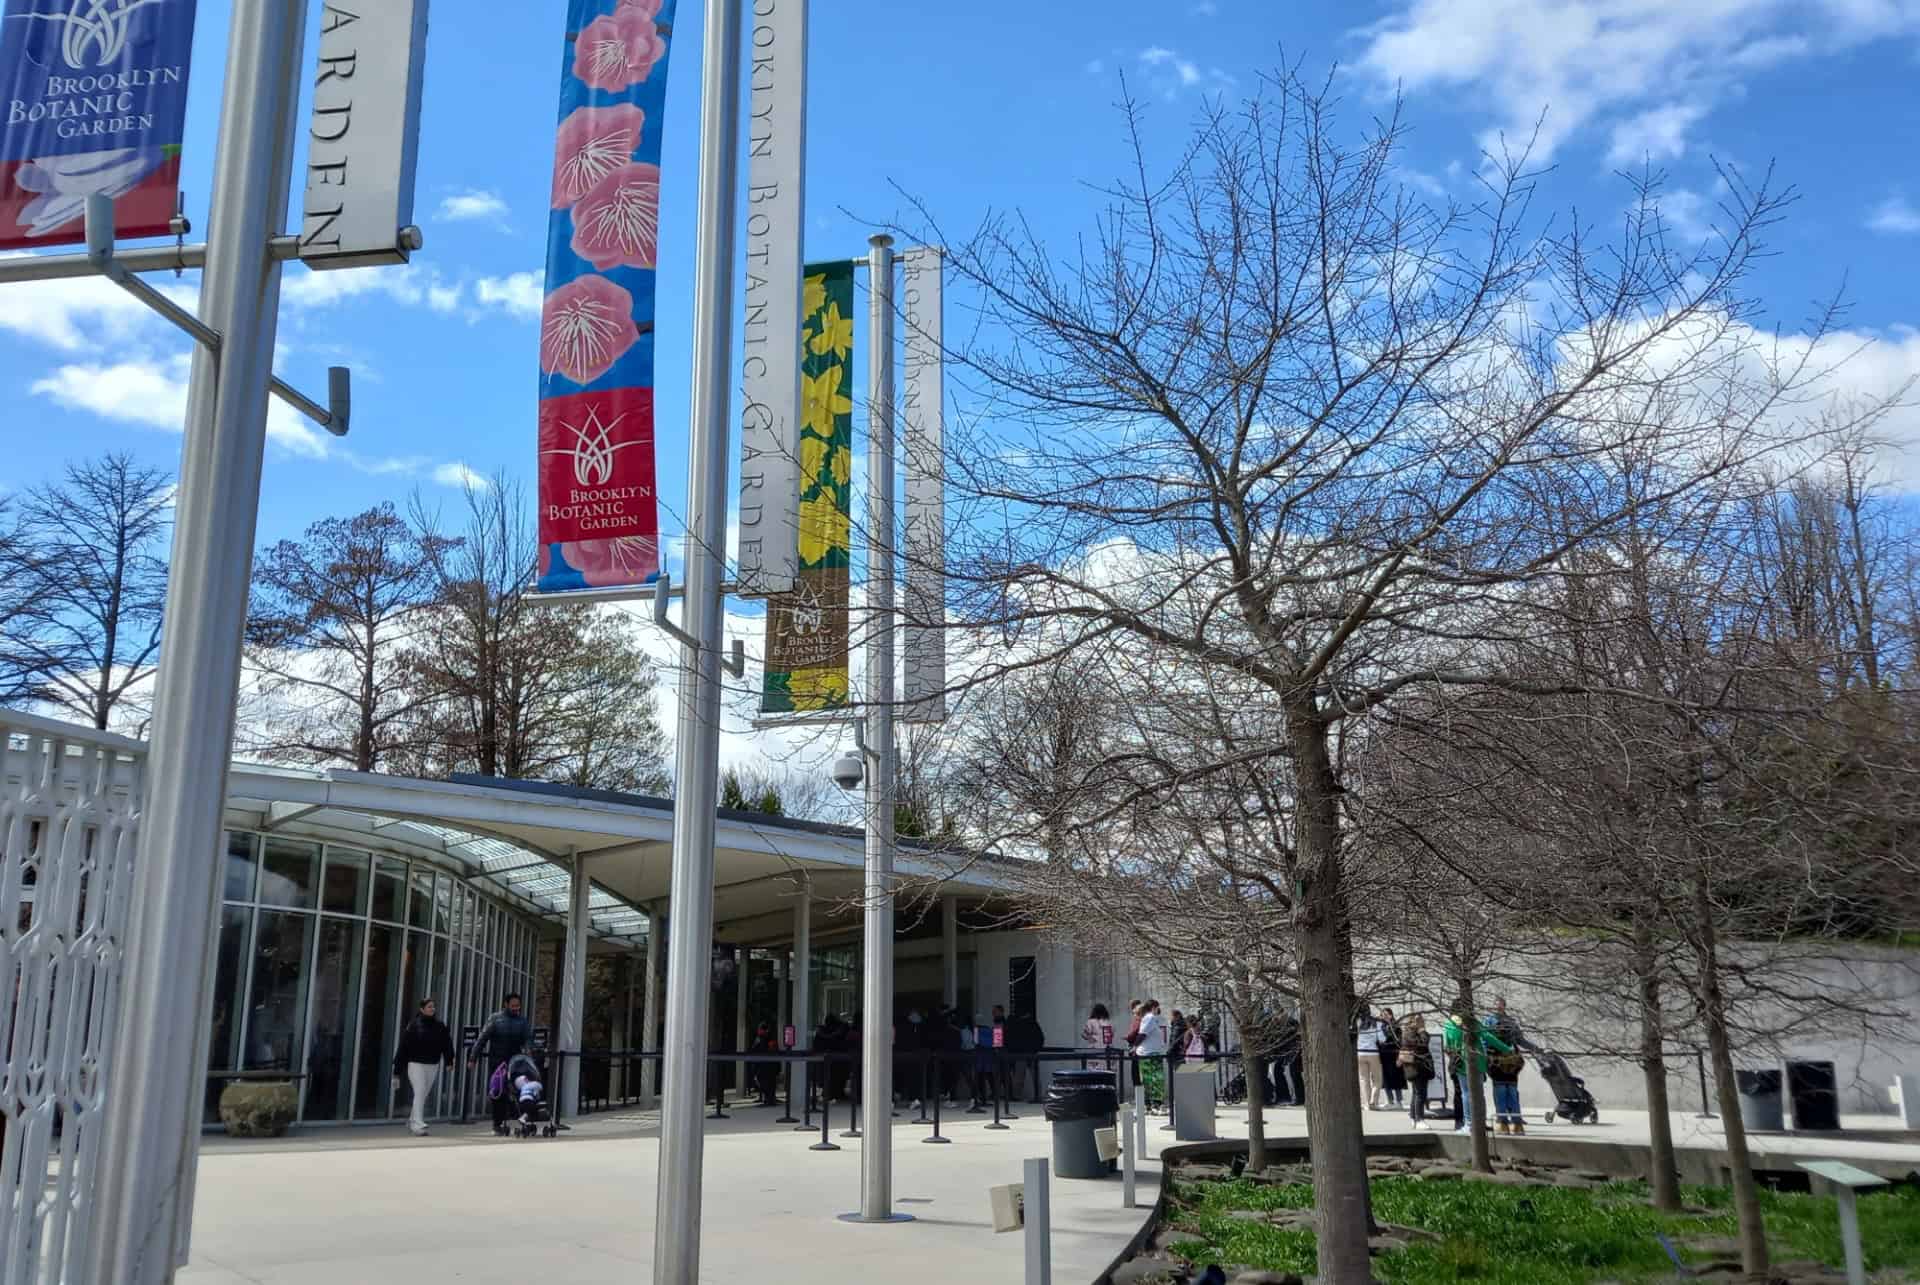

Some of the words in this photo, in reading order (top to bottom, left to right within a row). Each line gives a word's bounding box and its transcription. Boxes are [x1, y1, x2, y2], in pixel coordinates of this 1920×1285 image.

[46, 67, 182, 97] BROOKLYN
[6, 91, 134, 125] BOTANIC
[57, 114, 153, 138] GARDEN
[743, 181, 778, 378] BOTANIC
[904, 249, 924, 408] BROOKLYN
[570, 486, 651, 504] BROOKLYN
[739, 402, 773, 591] GARDEN
[549, 501, 624, 520] BOTANIC
[580, 515, 638, 530] GARDEN
